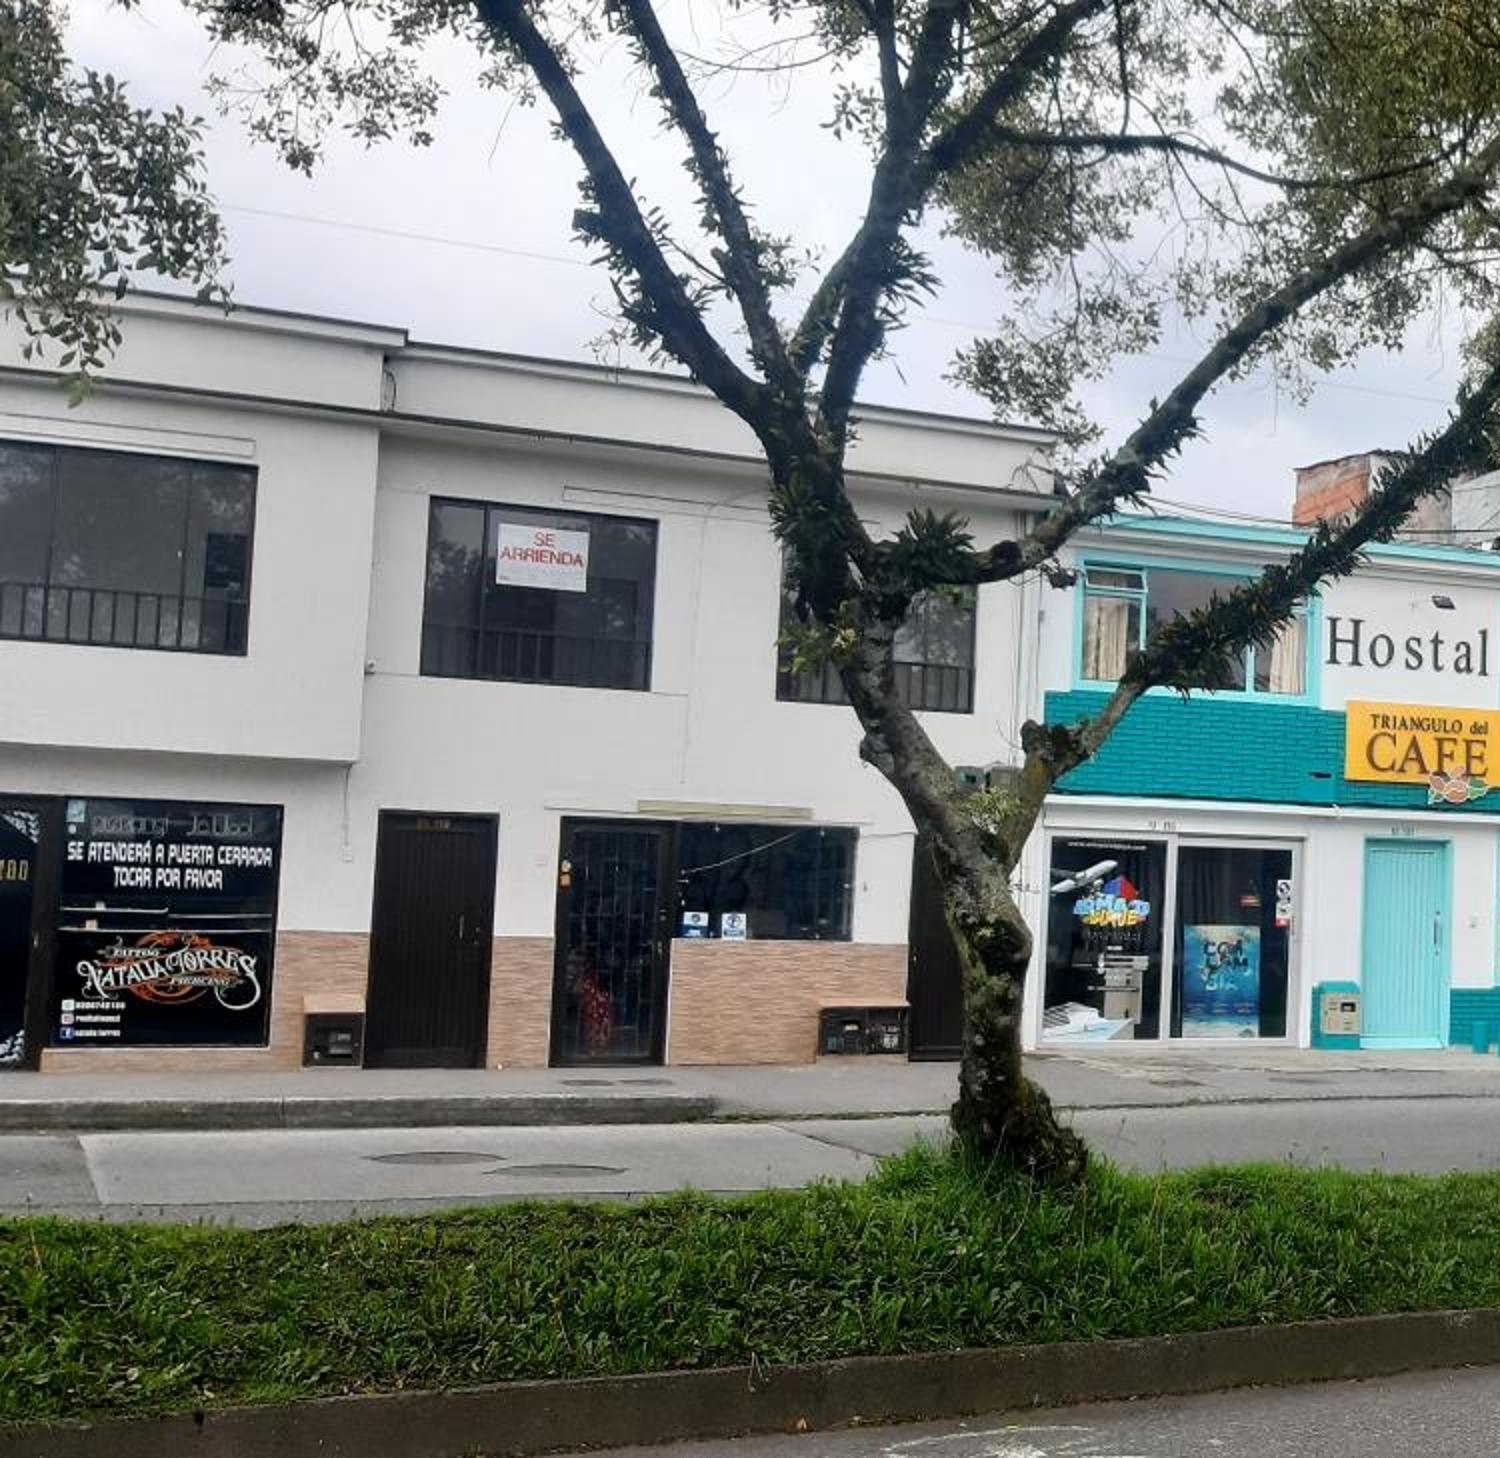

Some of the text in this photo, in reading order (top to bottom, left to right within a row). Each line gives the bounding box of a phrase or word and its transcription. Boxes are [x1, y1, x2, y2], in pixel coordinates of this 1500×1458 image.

[534, 532, 555, 548] SE
[500, 546, 584, 567] ARRIENDA
[1325, 616, 1489, 677] Hostal
[1370, 713, 1489, 735] TRIANGULO del
[1366, 732, 1488, 778] CAFE
[67, 840, 273, 868] SE ATENDERÁ A PUERTA CERRADA
[113, 865, 223, 891] TOCAR POR FAVOR
[77, 944, 262, 1010] NATALIA TORRES
